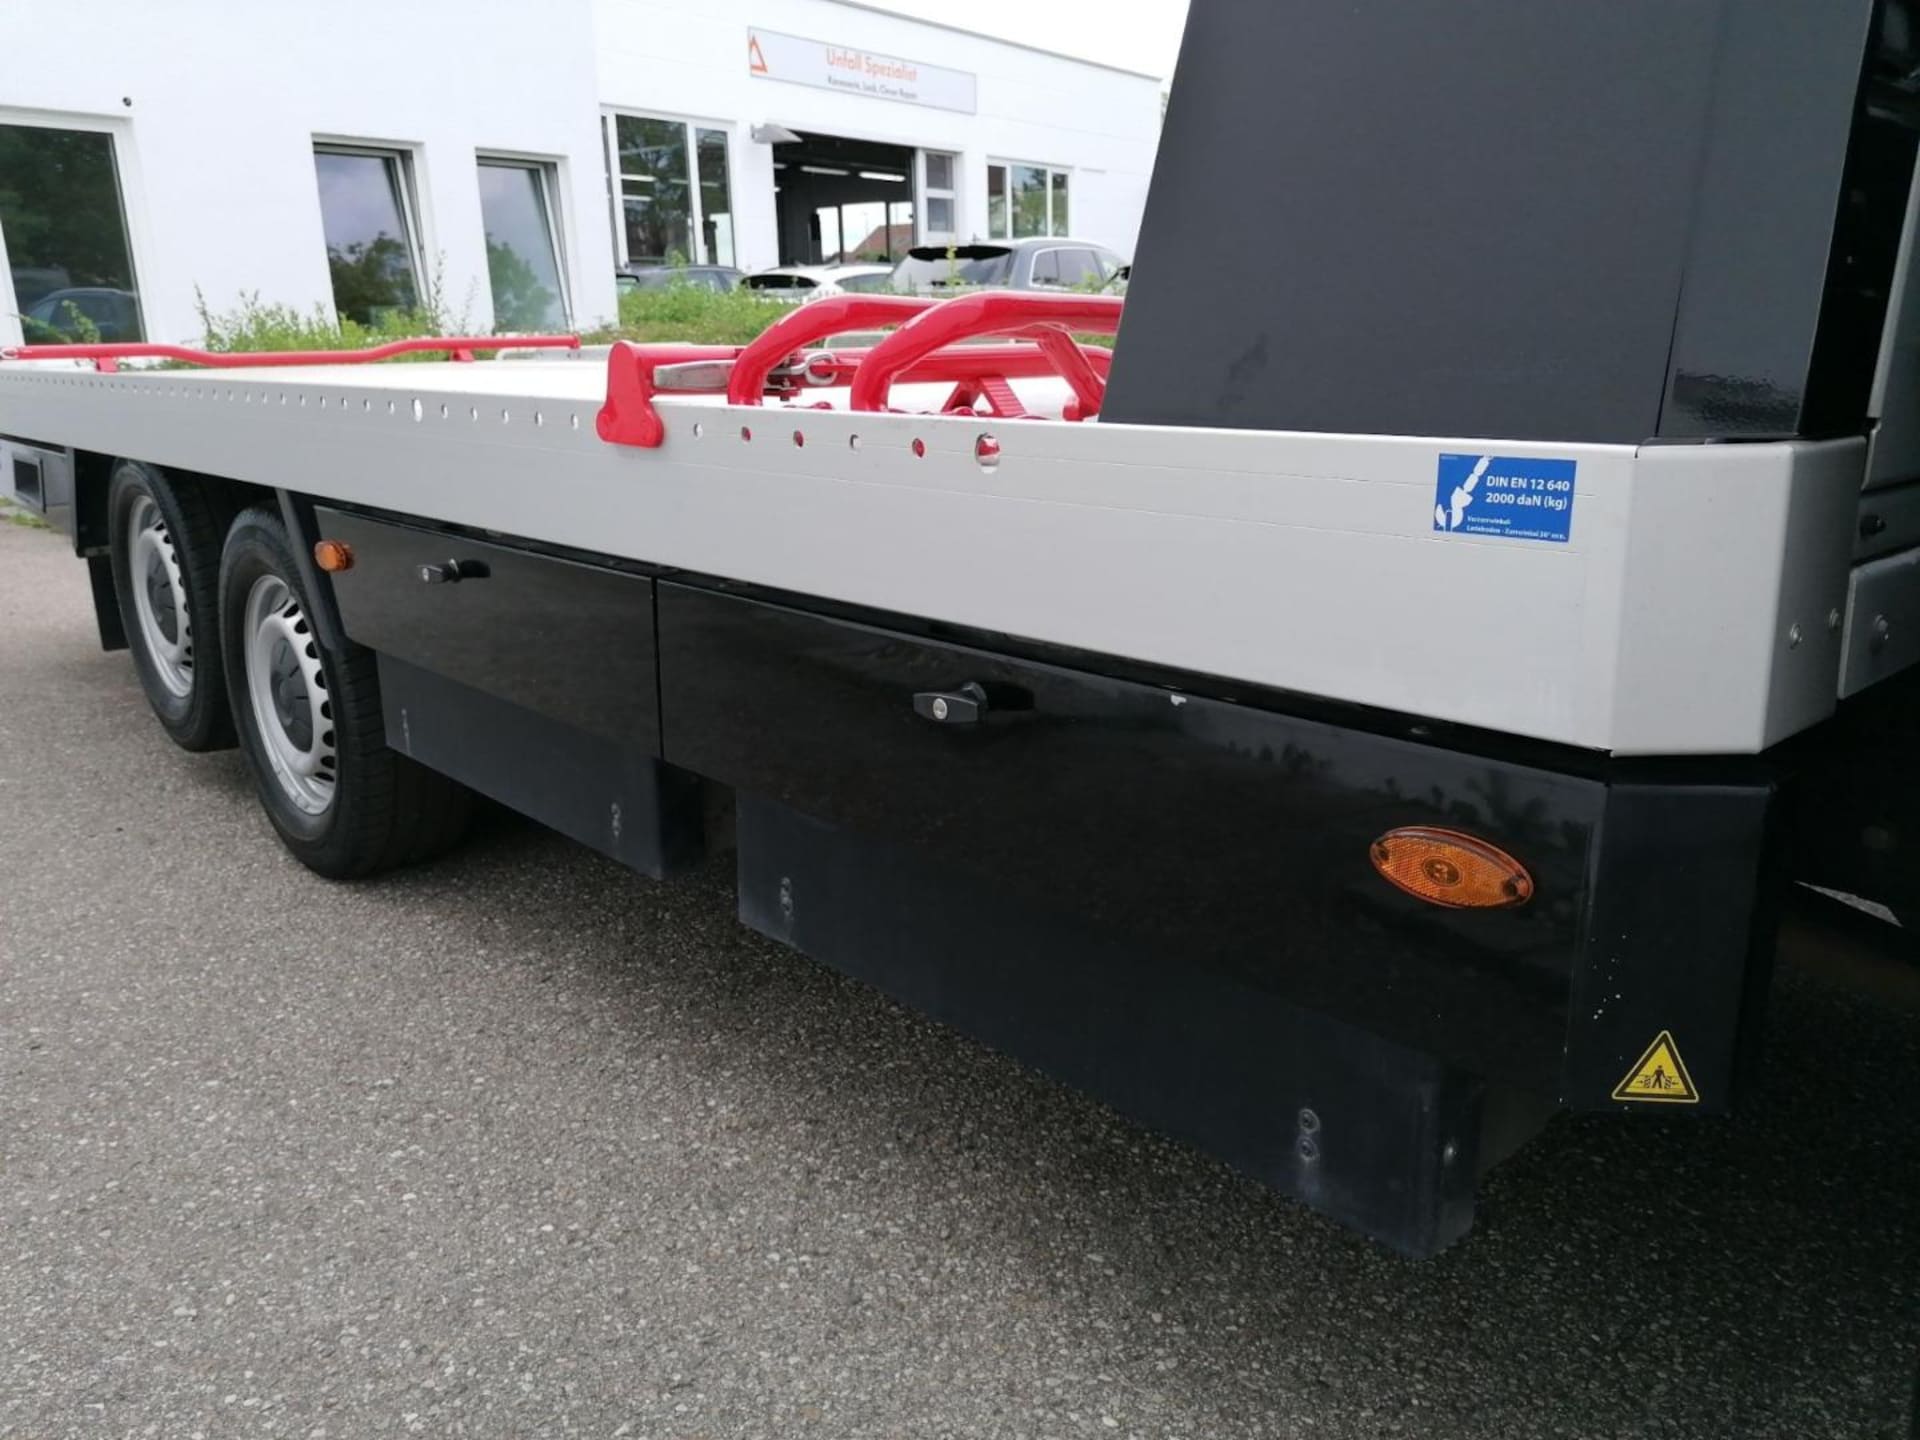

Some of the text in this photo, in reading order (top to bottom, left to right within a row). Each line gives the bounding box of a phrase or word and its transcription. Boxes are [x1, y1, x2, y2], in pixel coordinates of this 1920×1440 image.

[826, 47, 918, 81] Unfall Spezialist
[1486, 475, 1570, 491] DIN EN 12 640
[1485, 492, 1568, 511] 2000 daN (kg)
